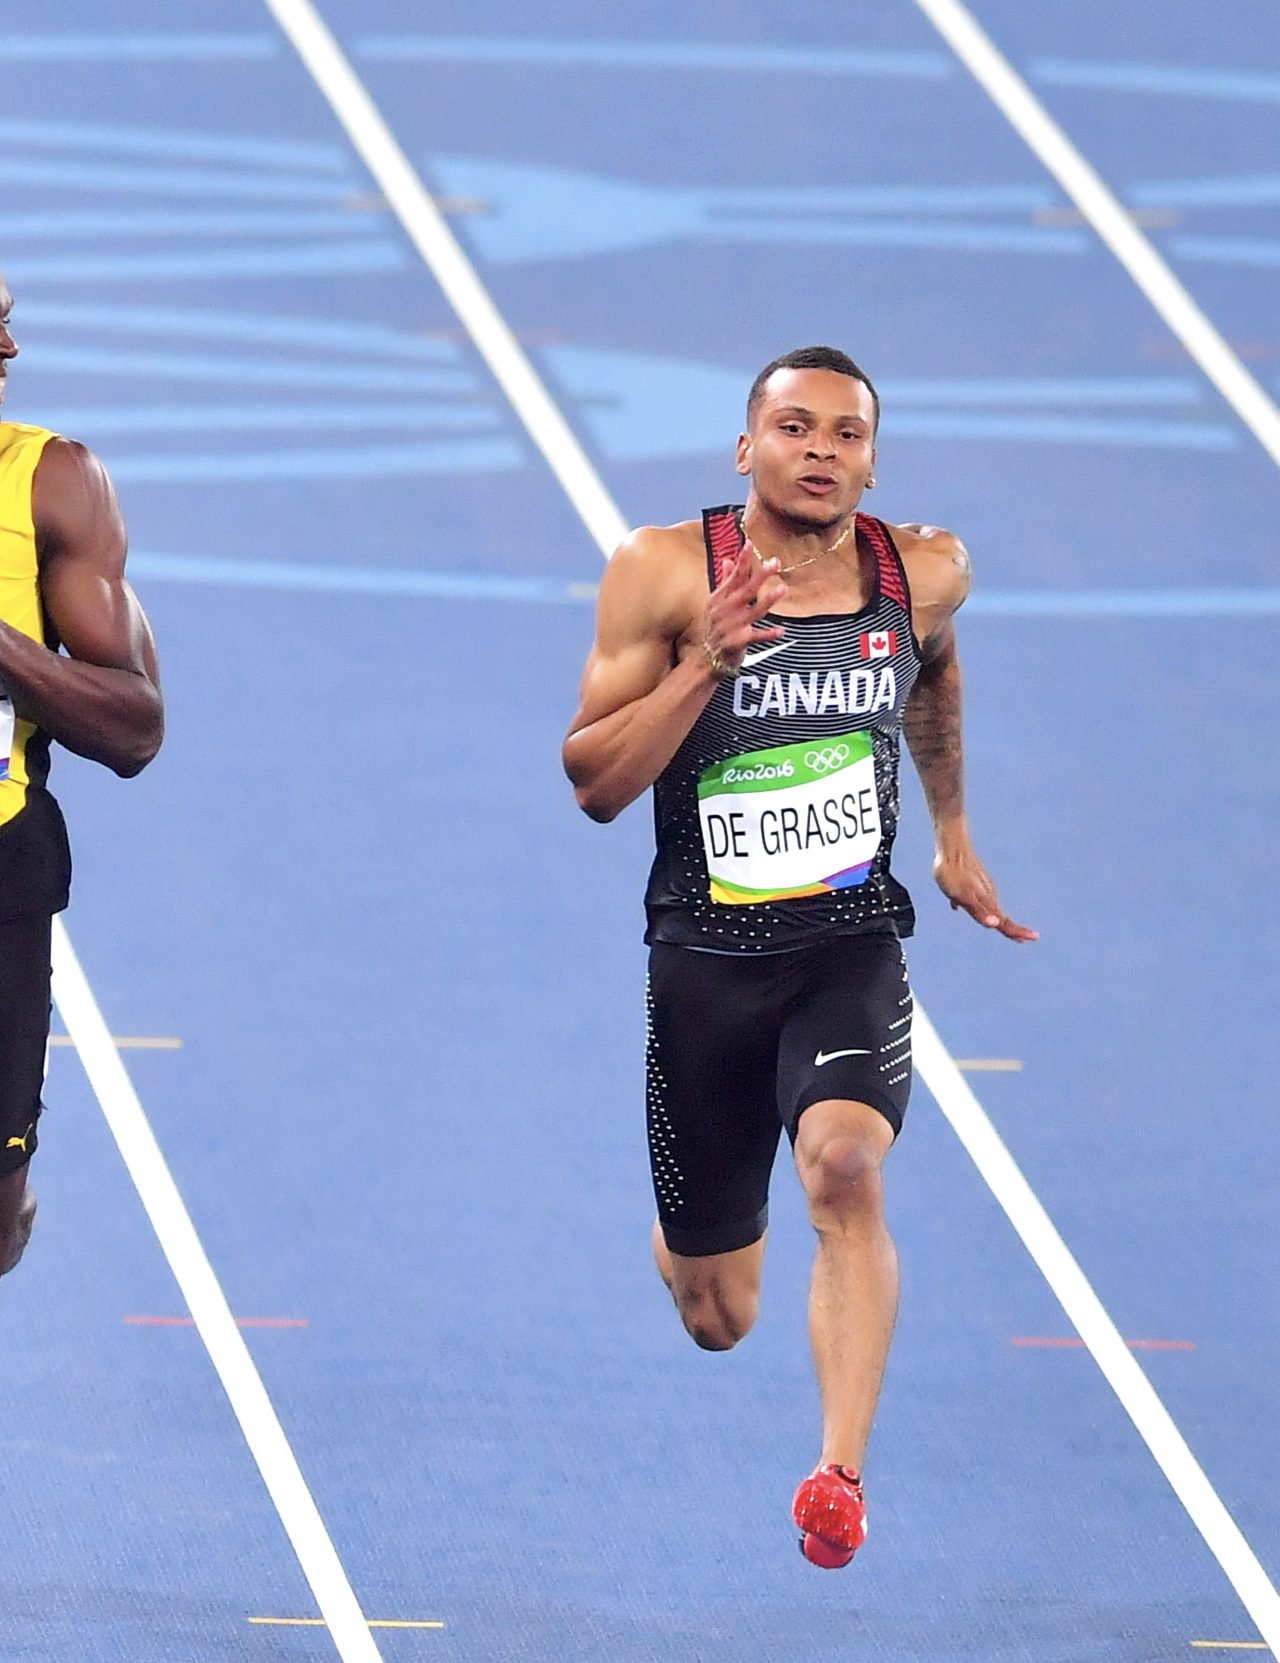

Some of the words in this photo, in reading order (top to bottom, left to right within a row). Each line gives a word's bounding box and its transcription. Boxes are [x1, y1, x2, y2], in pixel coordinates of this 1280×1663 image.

[732, 666, 896, 718] CANADA
[707, 812, 750, 859] DE
[760, 788, 877, 856] GRASSE
